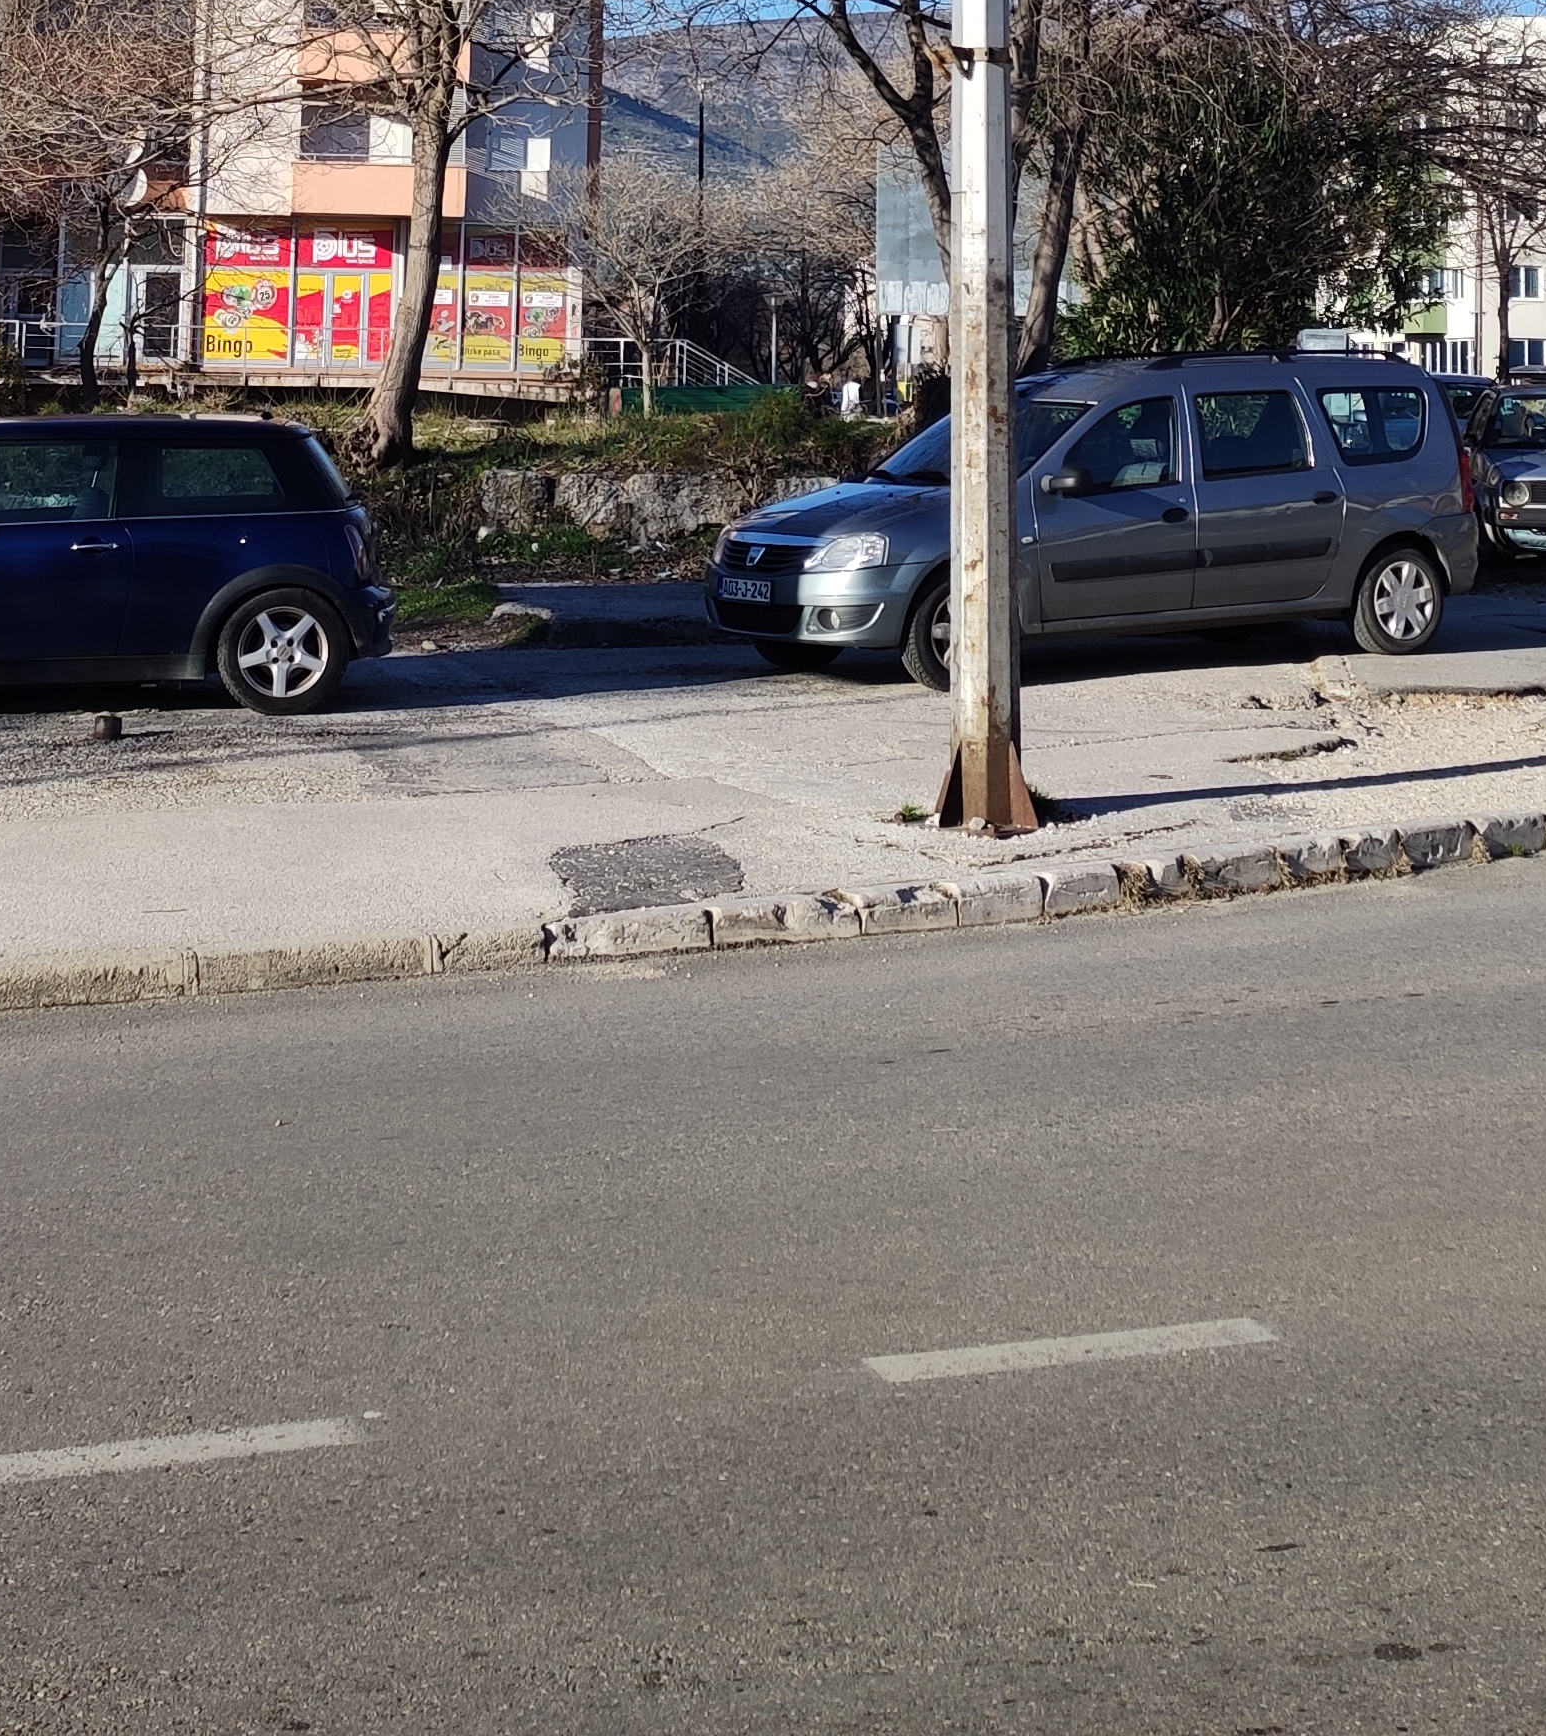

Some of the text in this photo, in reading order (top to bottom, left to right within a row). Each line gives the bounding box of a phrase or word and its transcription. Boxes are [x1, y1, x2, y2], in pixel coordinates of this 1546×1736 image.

[259, 290, 271, 302] 25
[206, 334, 253, 358] Bingo
[483, 347, 501, 356] pasa
[519, 344, 549, 360] Bingo
[723, 579, 770, 600] A03-J-242
